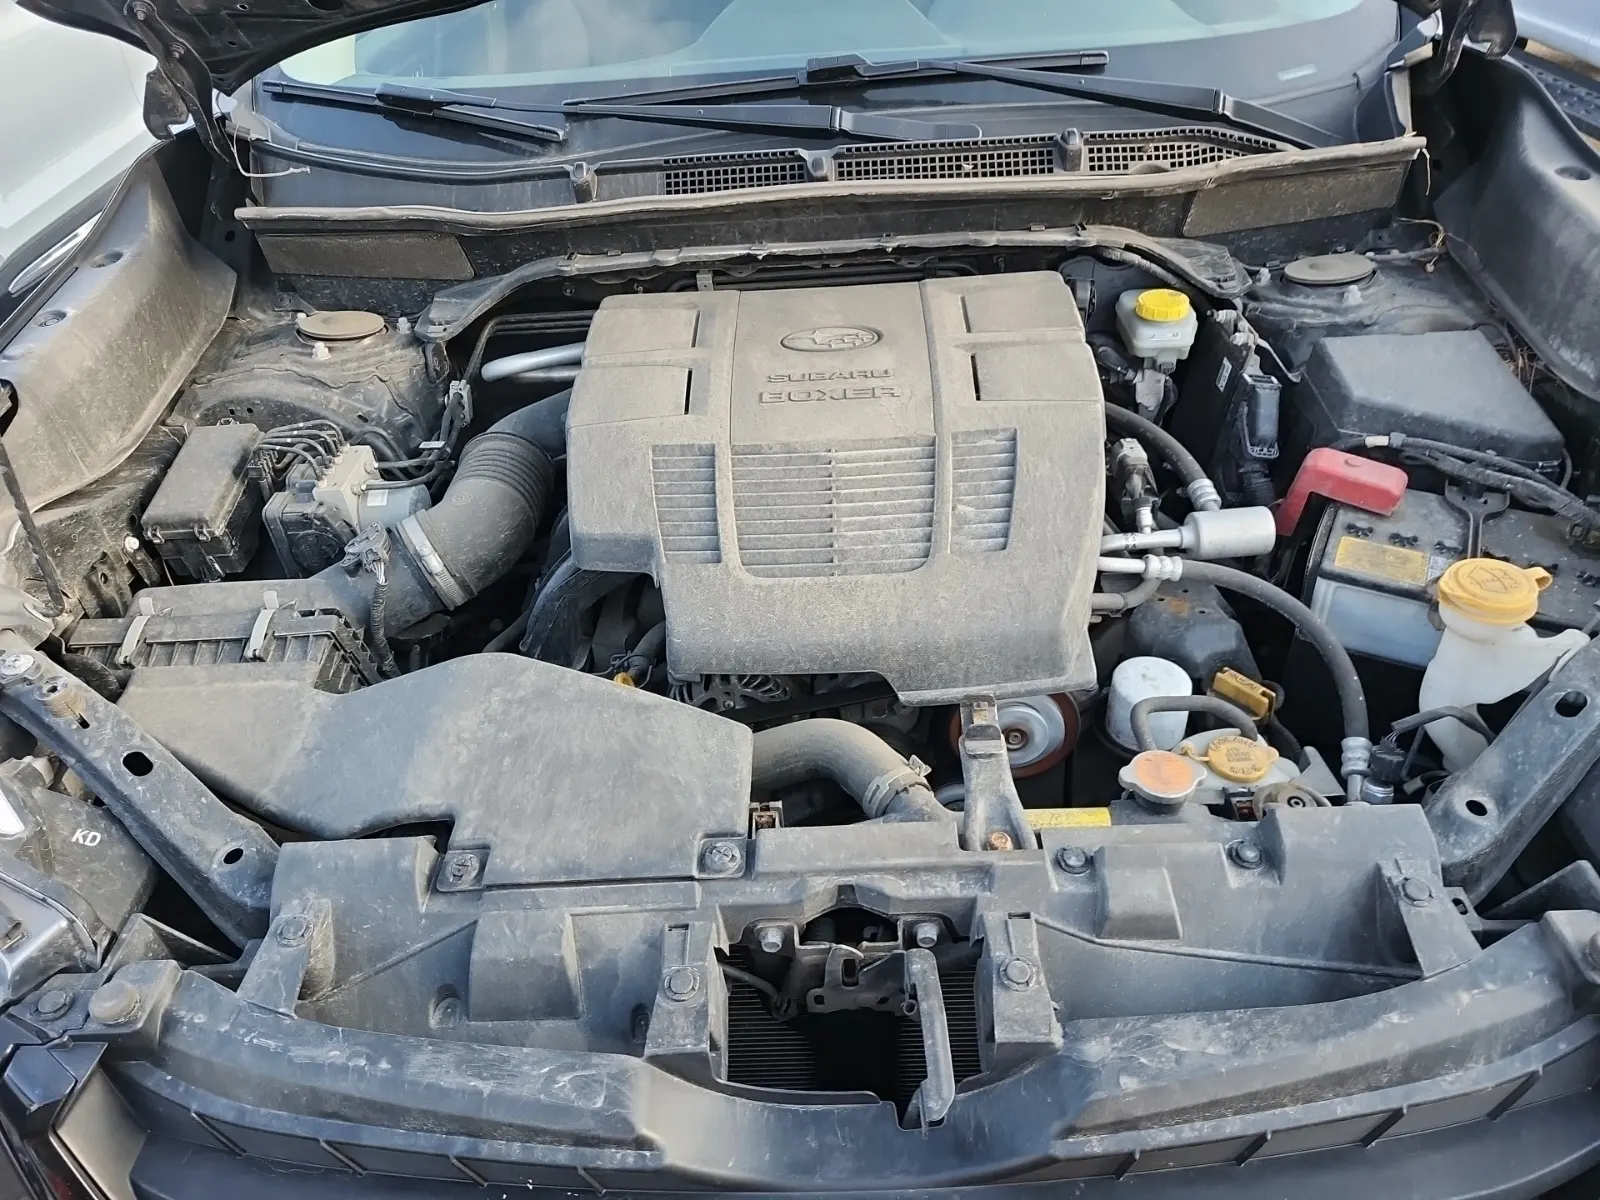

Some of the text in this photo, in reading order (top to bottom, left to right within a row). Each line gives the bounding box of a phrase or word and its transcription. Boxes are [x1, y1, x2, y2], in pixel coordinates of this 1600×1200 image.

[767, 368, 893, 383] SUBARU
[759, 385, 902, 404] BOXER
[71, 828, 102, 847] KD
